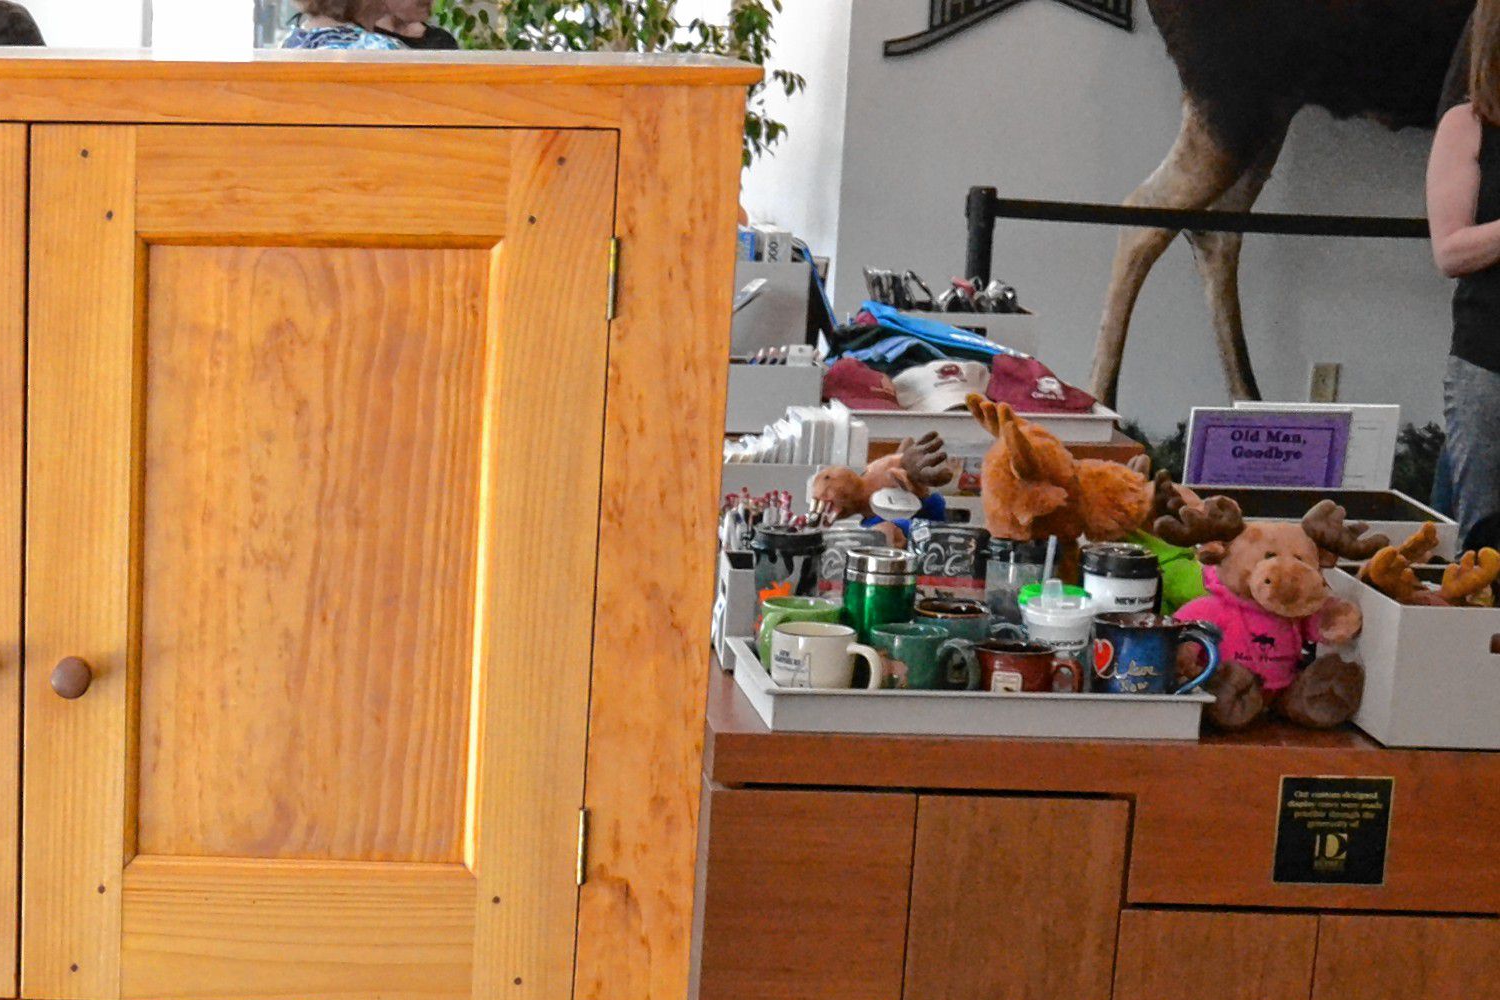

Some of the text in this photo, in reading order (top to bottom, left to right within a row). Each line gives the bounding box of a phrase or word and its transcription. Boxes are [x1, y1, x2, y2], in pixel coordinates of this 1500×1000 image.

[1230, 430, 1307, 445] Old Man,
[1231, 446, 1303, 462] Goodbye
